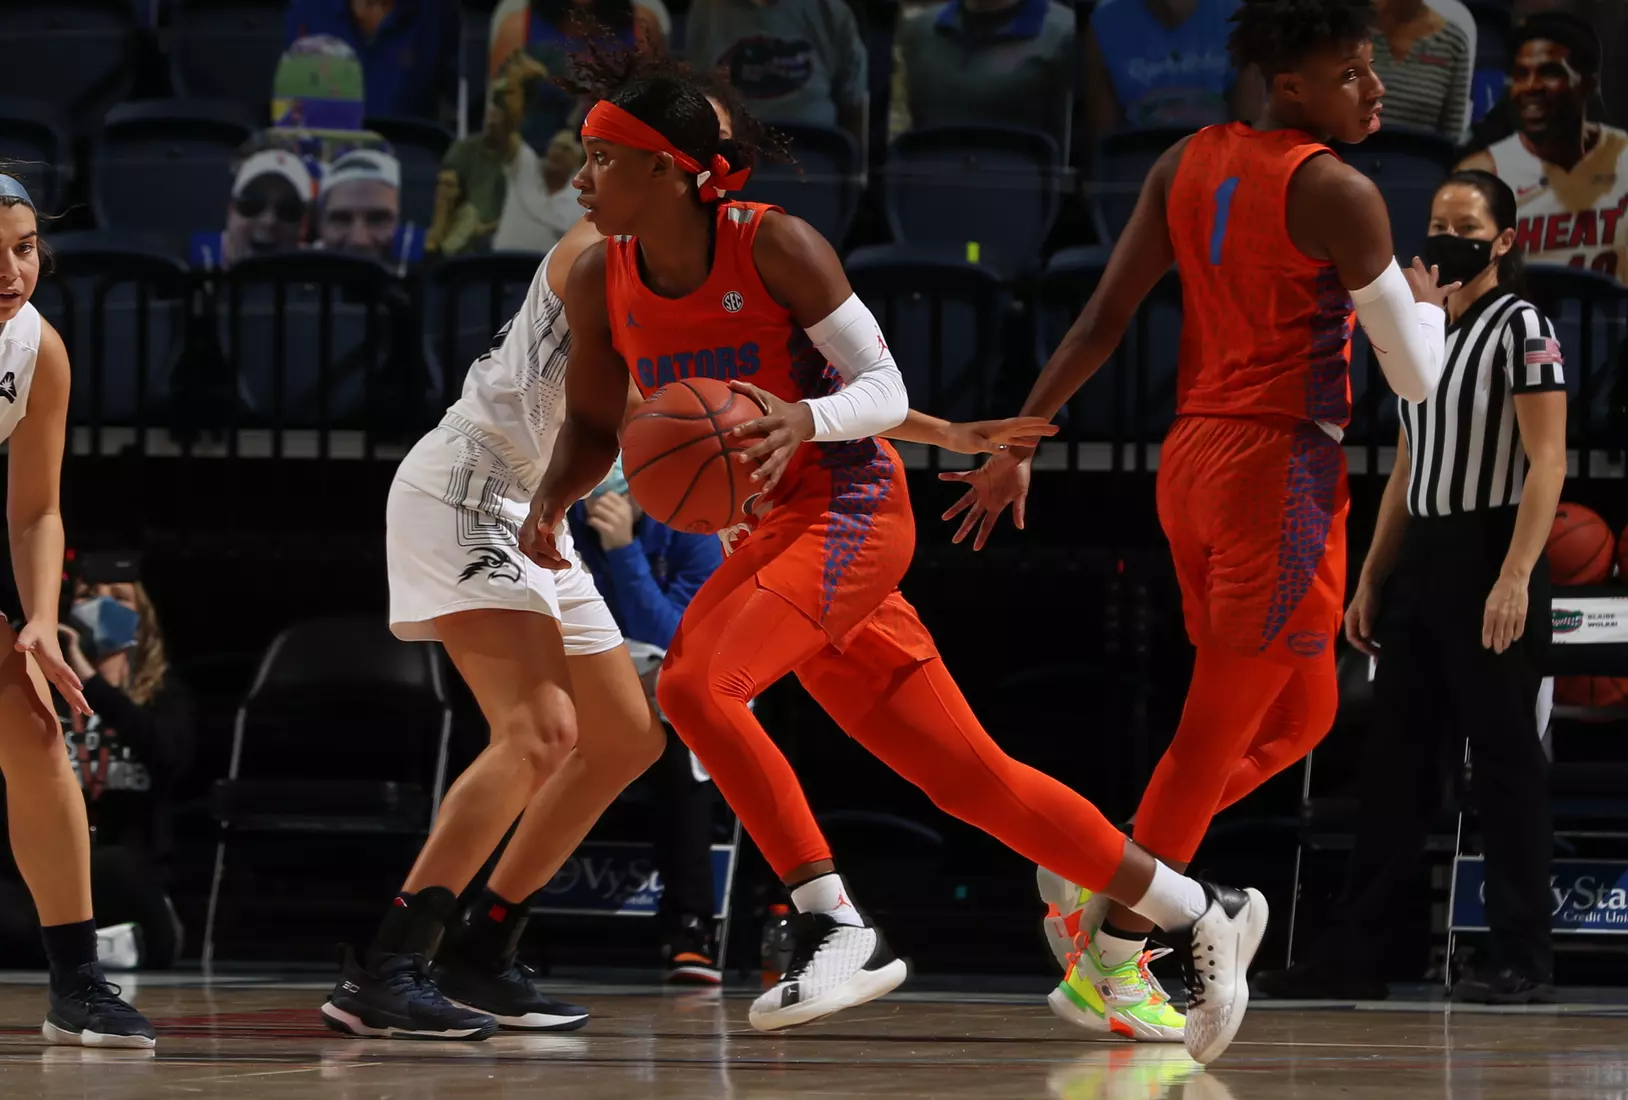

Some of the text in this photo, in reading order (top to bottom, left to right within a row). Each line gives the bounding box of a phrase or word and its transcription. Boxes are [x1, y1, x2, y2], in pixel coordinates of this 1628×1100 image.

[1210, 176, 1240, 266] 1
[1516, 203, 1627, 254] HEAT
[724, 291, 743, 311] SEC
[637, 341, 761, 389] GATORS
